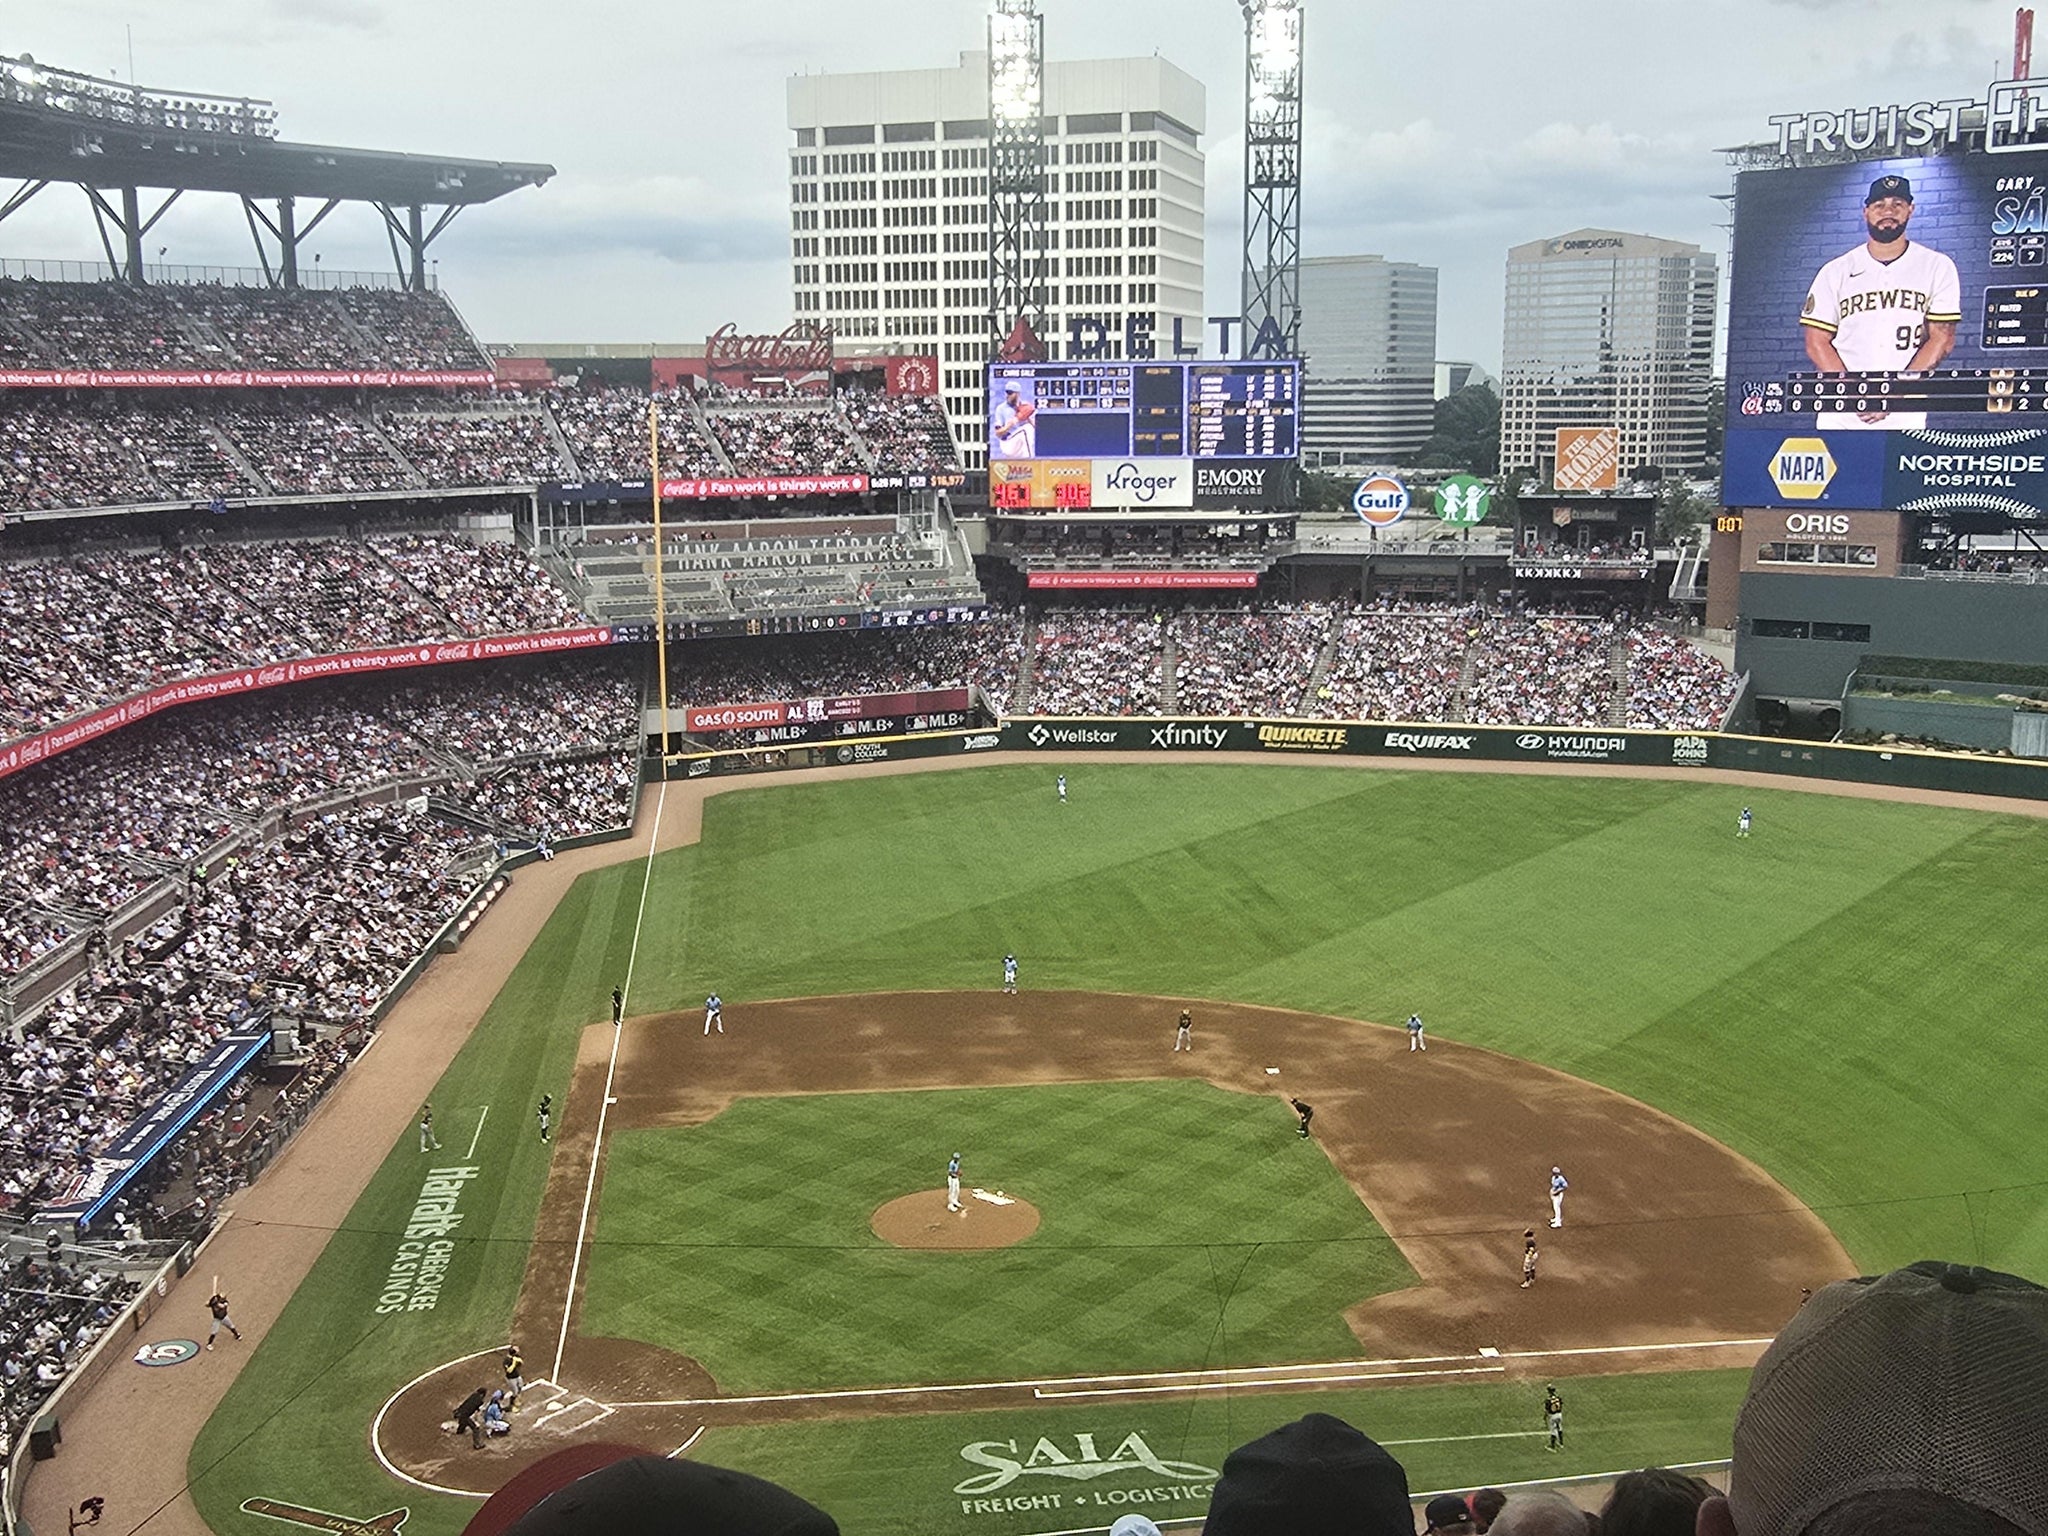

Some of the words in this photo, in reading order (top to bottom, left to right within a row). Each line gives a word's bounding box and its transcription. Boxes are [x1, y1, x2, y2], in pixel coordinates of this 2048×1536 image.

[1768, 98, 1975, 156] TRUIST
[1995, 176, 2034, 192] GARY
[1991, 187, 2048, 235] SÁ
[1563, 238, 1624, 251] ONEDIGITAL
[1839, 289, 1930, 320] BREWER
[1072, 316, 1288, 356] DELTA
[2020, 382, 2030, 393] 4
[1881, 400, 1887, 411] 1
[2019, 399, 2029, 410] 2
[1563, 434, 1589, 459] THE
[1555, 428, 1619, 490] HOME
[1899, 455, 2045, 472] NORTHSIDE
[1197, 469, 1266, 486] EMORY
[1579, 448, 1618, 491] DEPOT
[1780, 456, 1825, 481] NAPA
[711, 482, 733, 493] Fan
[735, 481, 766, 492] work
[767, 480, 777, 491] is
[780, 480, 818, 492] thirsty
[820, 479, 849, 490] work
[1107, 463, 1177, 502] Kroger
[1923, 474, 2016, 486] HOSPITAL
[1197, 487, 1263, 496] HEALTHCARE
[1358, 493, 1403, 508] Gulf
[1786, 513, 1849, 534] ORIS
[1639, 569, 1648, 578] 7
[484, 643, 503, 654] Fan
[504, 640, 529, 652] work
[530, 638, 539, 648] is
[540, 635, 572, 649] thirsty
[573, 633, 596, 645] work
[298, 664, 313, 676] Fan
[314, 660, 339, 673] work
[340, 658, 350, 669] is
[352, 653, 388, 668] thirsty
[389, 651, 416, 665] work
[177, 687, 186, 698] is
[187, 681, 218, 697] thirsty
[219, 676, 242, 691] work
[694, 713, 722, 727] GAS
[735, 709, 779, 723] SOUTH
[787, 707, 803, 720] AL
[929, 713, 966, 728] MLB+
[771, 726, 808, 740] MLB+
[1052, 728, 1117, 743] Wellstar
[1150, 722, 1228, 748] xfinity
[1258, 725, 1347, 743] QUIKRETE
[1384, 732, 1472, 751] EQUIFAX
[854, 743, 881, 752] SOUTH
[1549, 736, 1625, 750] HYUNDAI
[1673, 736, 1707, 749] PAPA
[854, 749, 888, 758] COLLEGE
[1672, 749, 1707, 759] JOHNS
[375, 1241, 425, 1314] CASINOS
[407, 1240, 454, 1312] CHEROKEE
[953, 1431, 1221, 1495] SAIA
[961, 1494, 1062, 1514] FREIGHT
[1094, 1484, 1214, 1506] LOGISTICS
